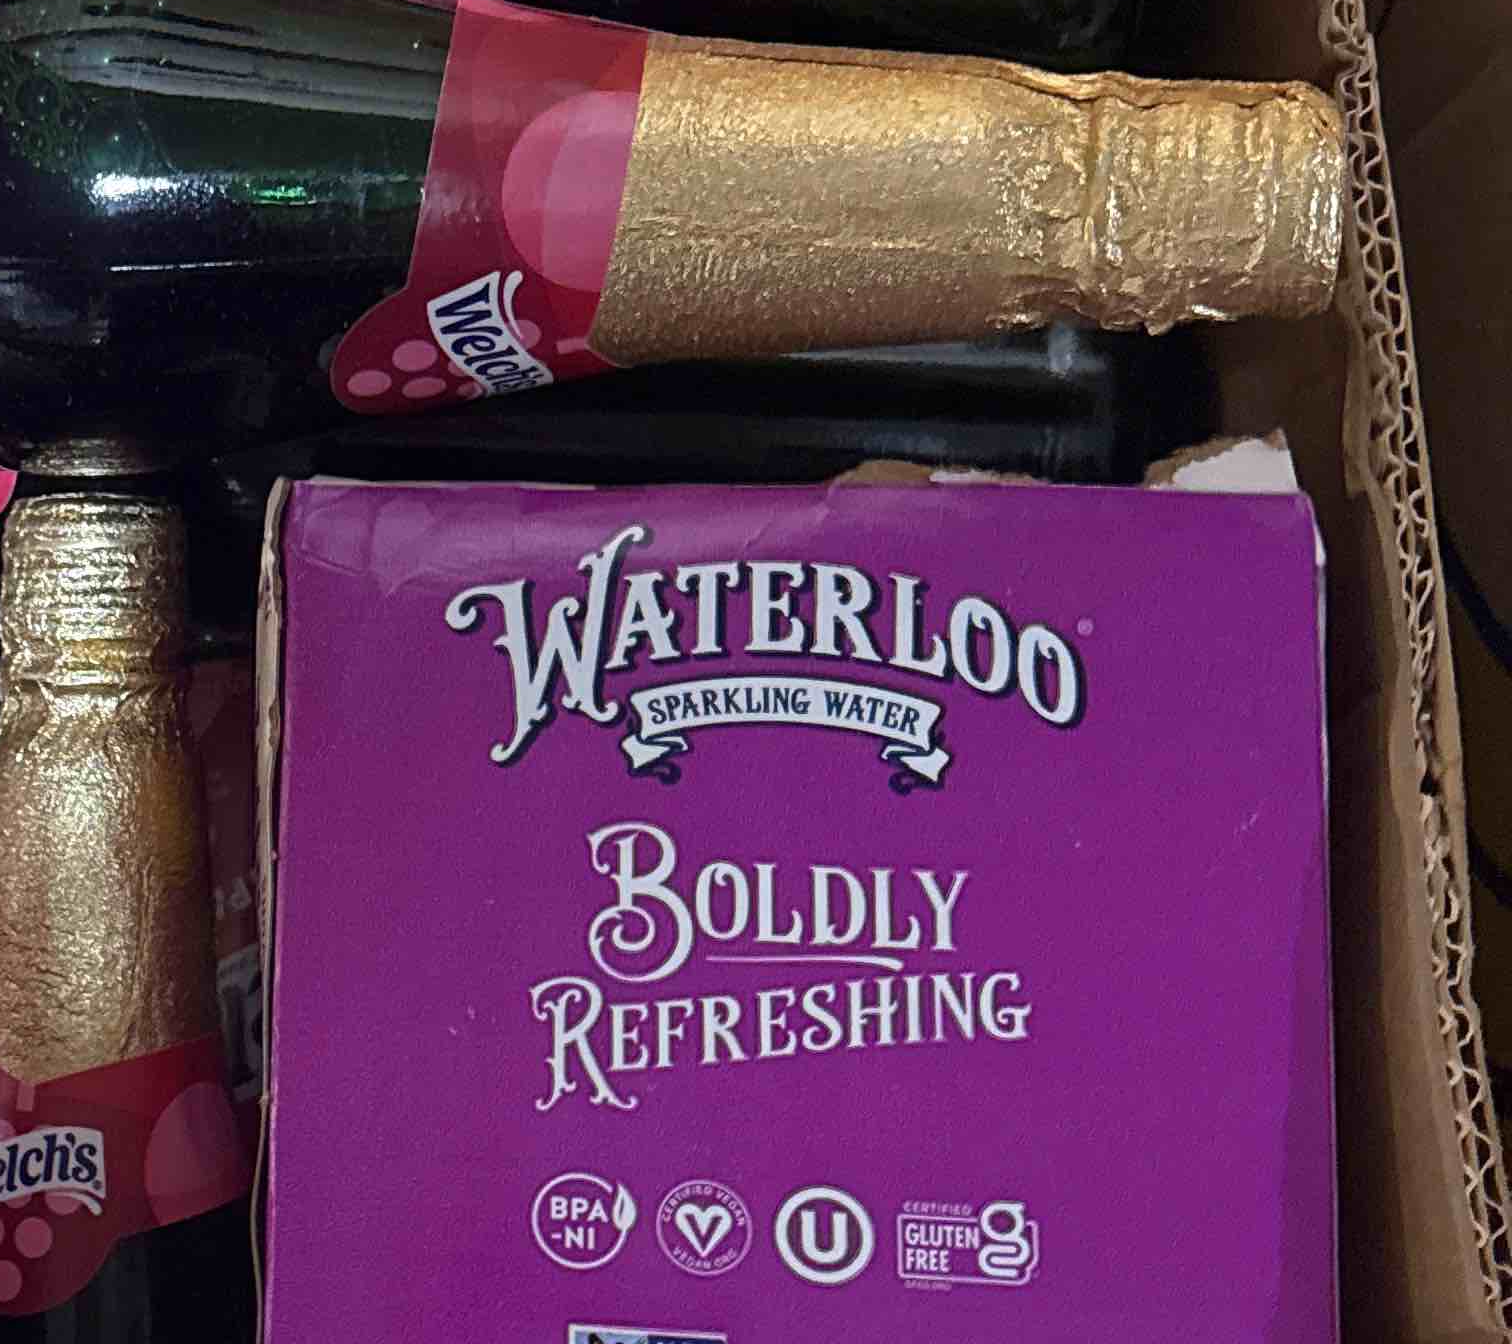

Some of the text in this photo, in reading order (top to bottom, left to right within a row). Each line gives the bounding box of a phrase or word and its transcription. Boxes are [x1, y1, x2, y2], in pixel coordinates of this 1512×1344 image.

[434, 281, 546, 394] Welch
[445, 522, 1085, 764] WATERLOO
[646, 686, 922, 736] SPARKLING WATER
[549, 1197, 608, 1222] BPA
[550, 1228, 597, 1251] -NI
[904, 1223, 981, 1250] GLUTEN
[904, 1250, 951, 1274] FREE
